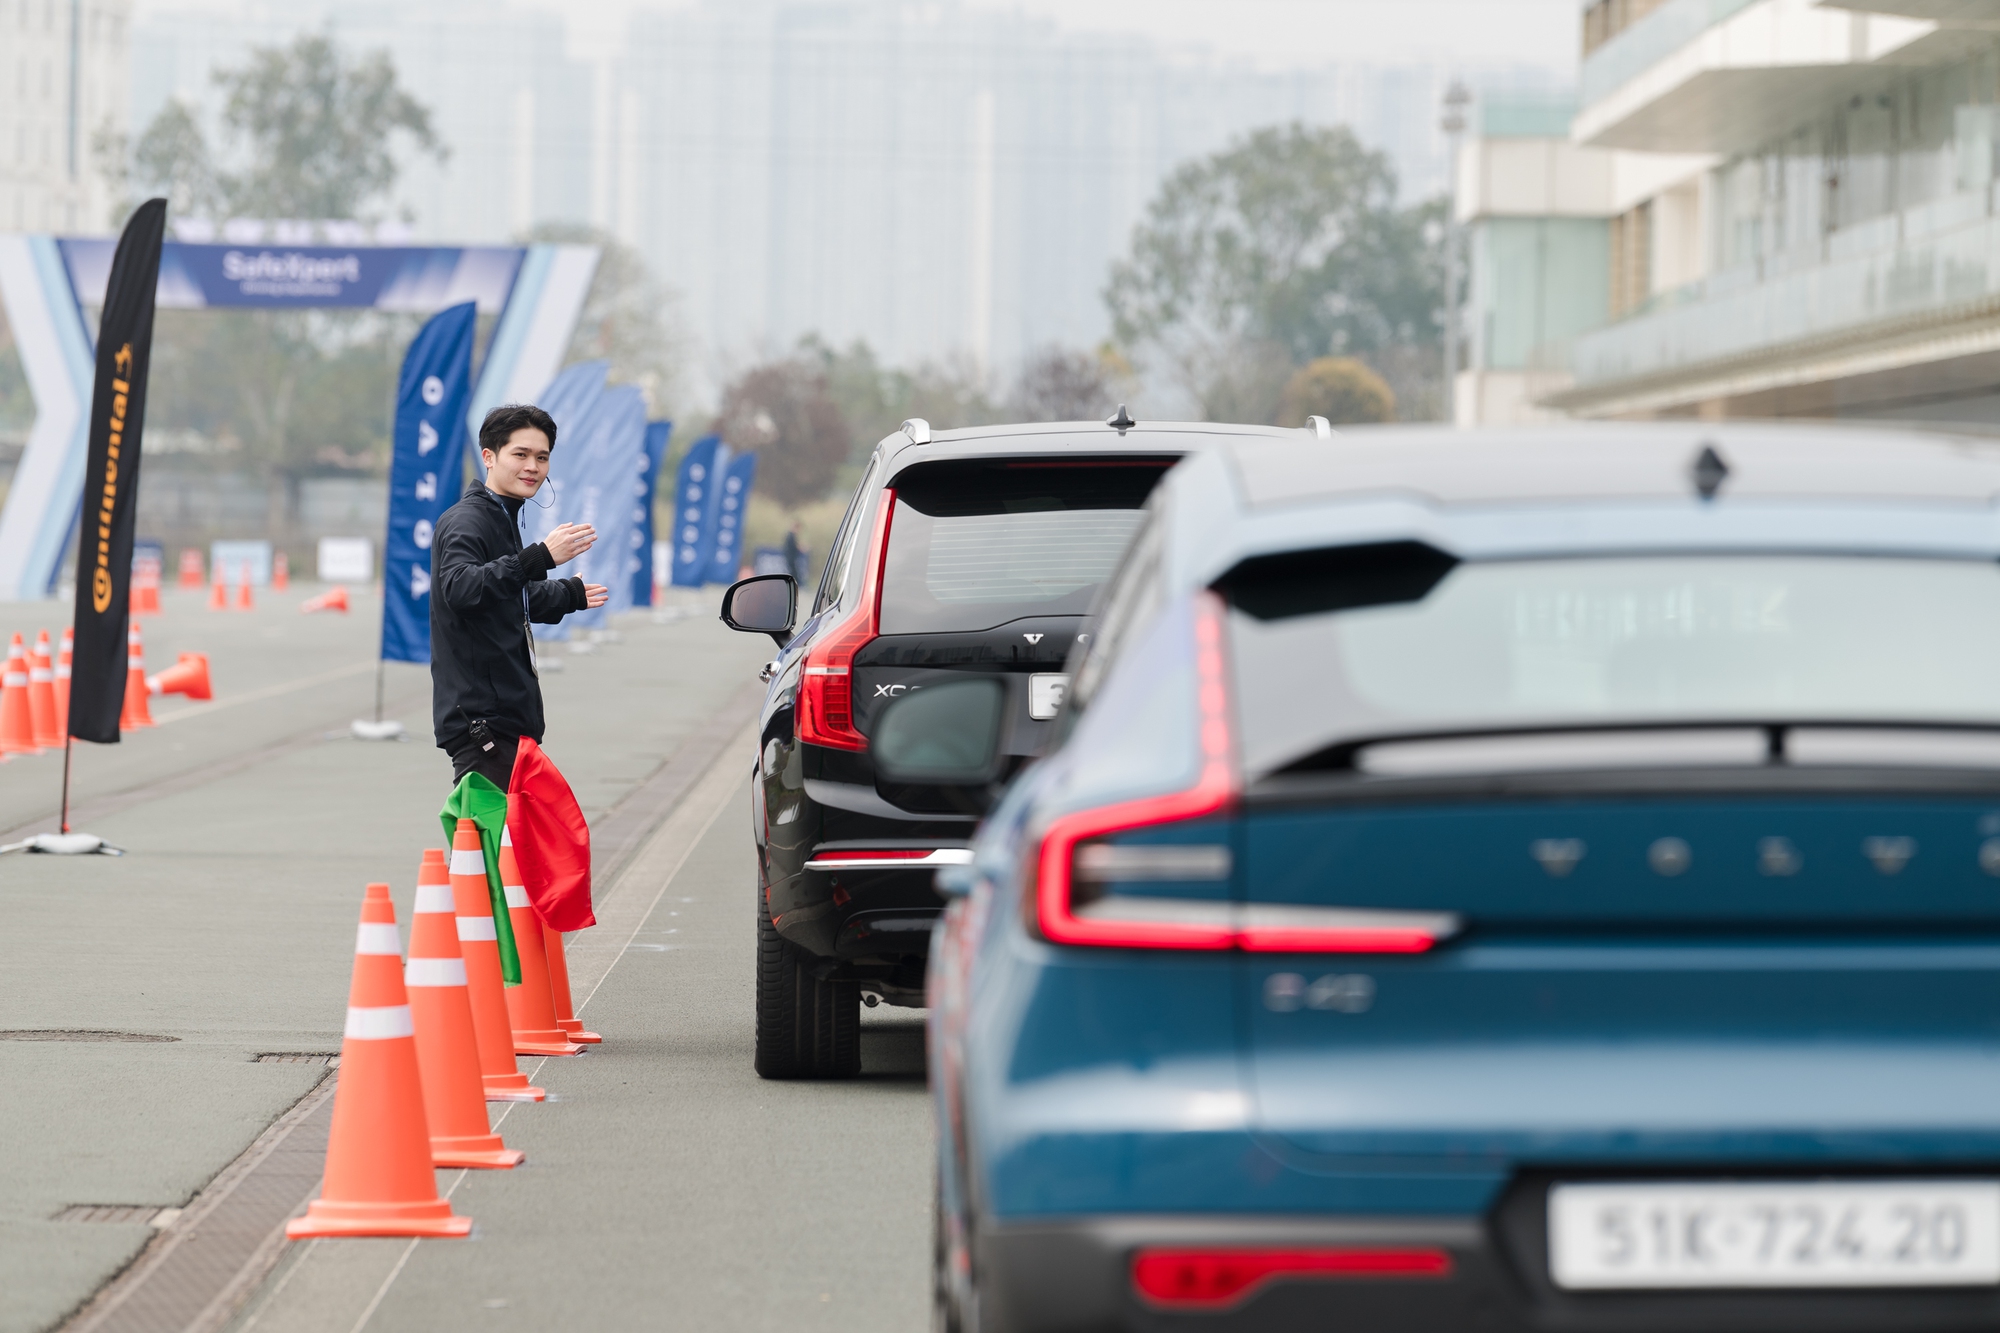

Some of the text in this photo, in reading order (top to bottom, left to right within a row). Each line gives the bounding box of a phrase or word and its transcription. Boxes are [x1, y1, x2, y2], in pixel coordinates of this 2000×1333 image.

[223, 250, 361, 283] SafeXpert
[93, 378, 131, 613] Continental
[411, 375, 444, 601] VOLVO
